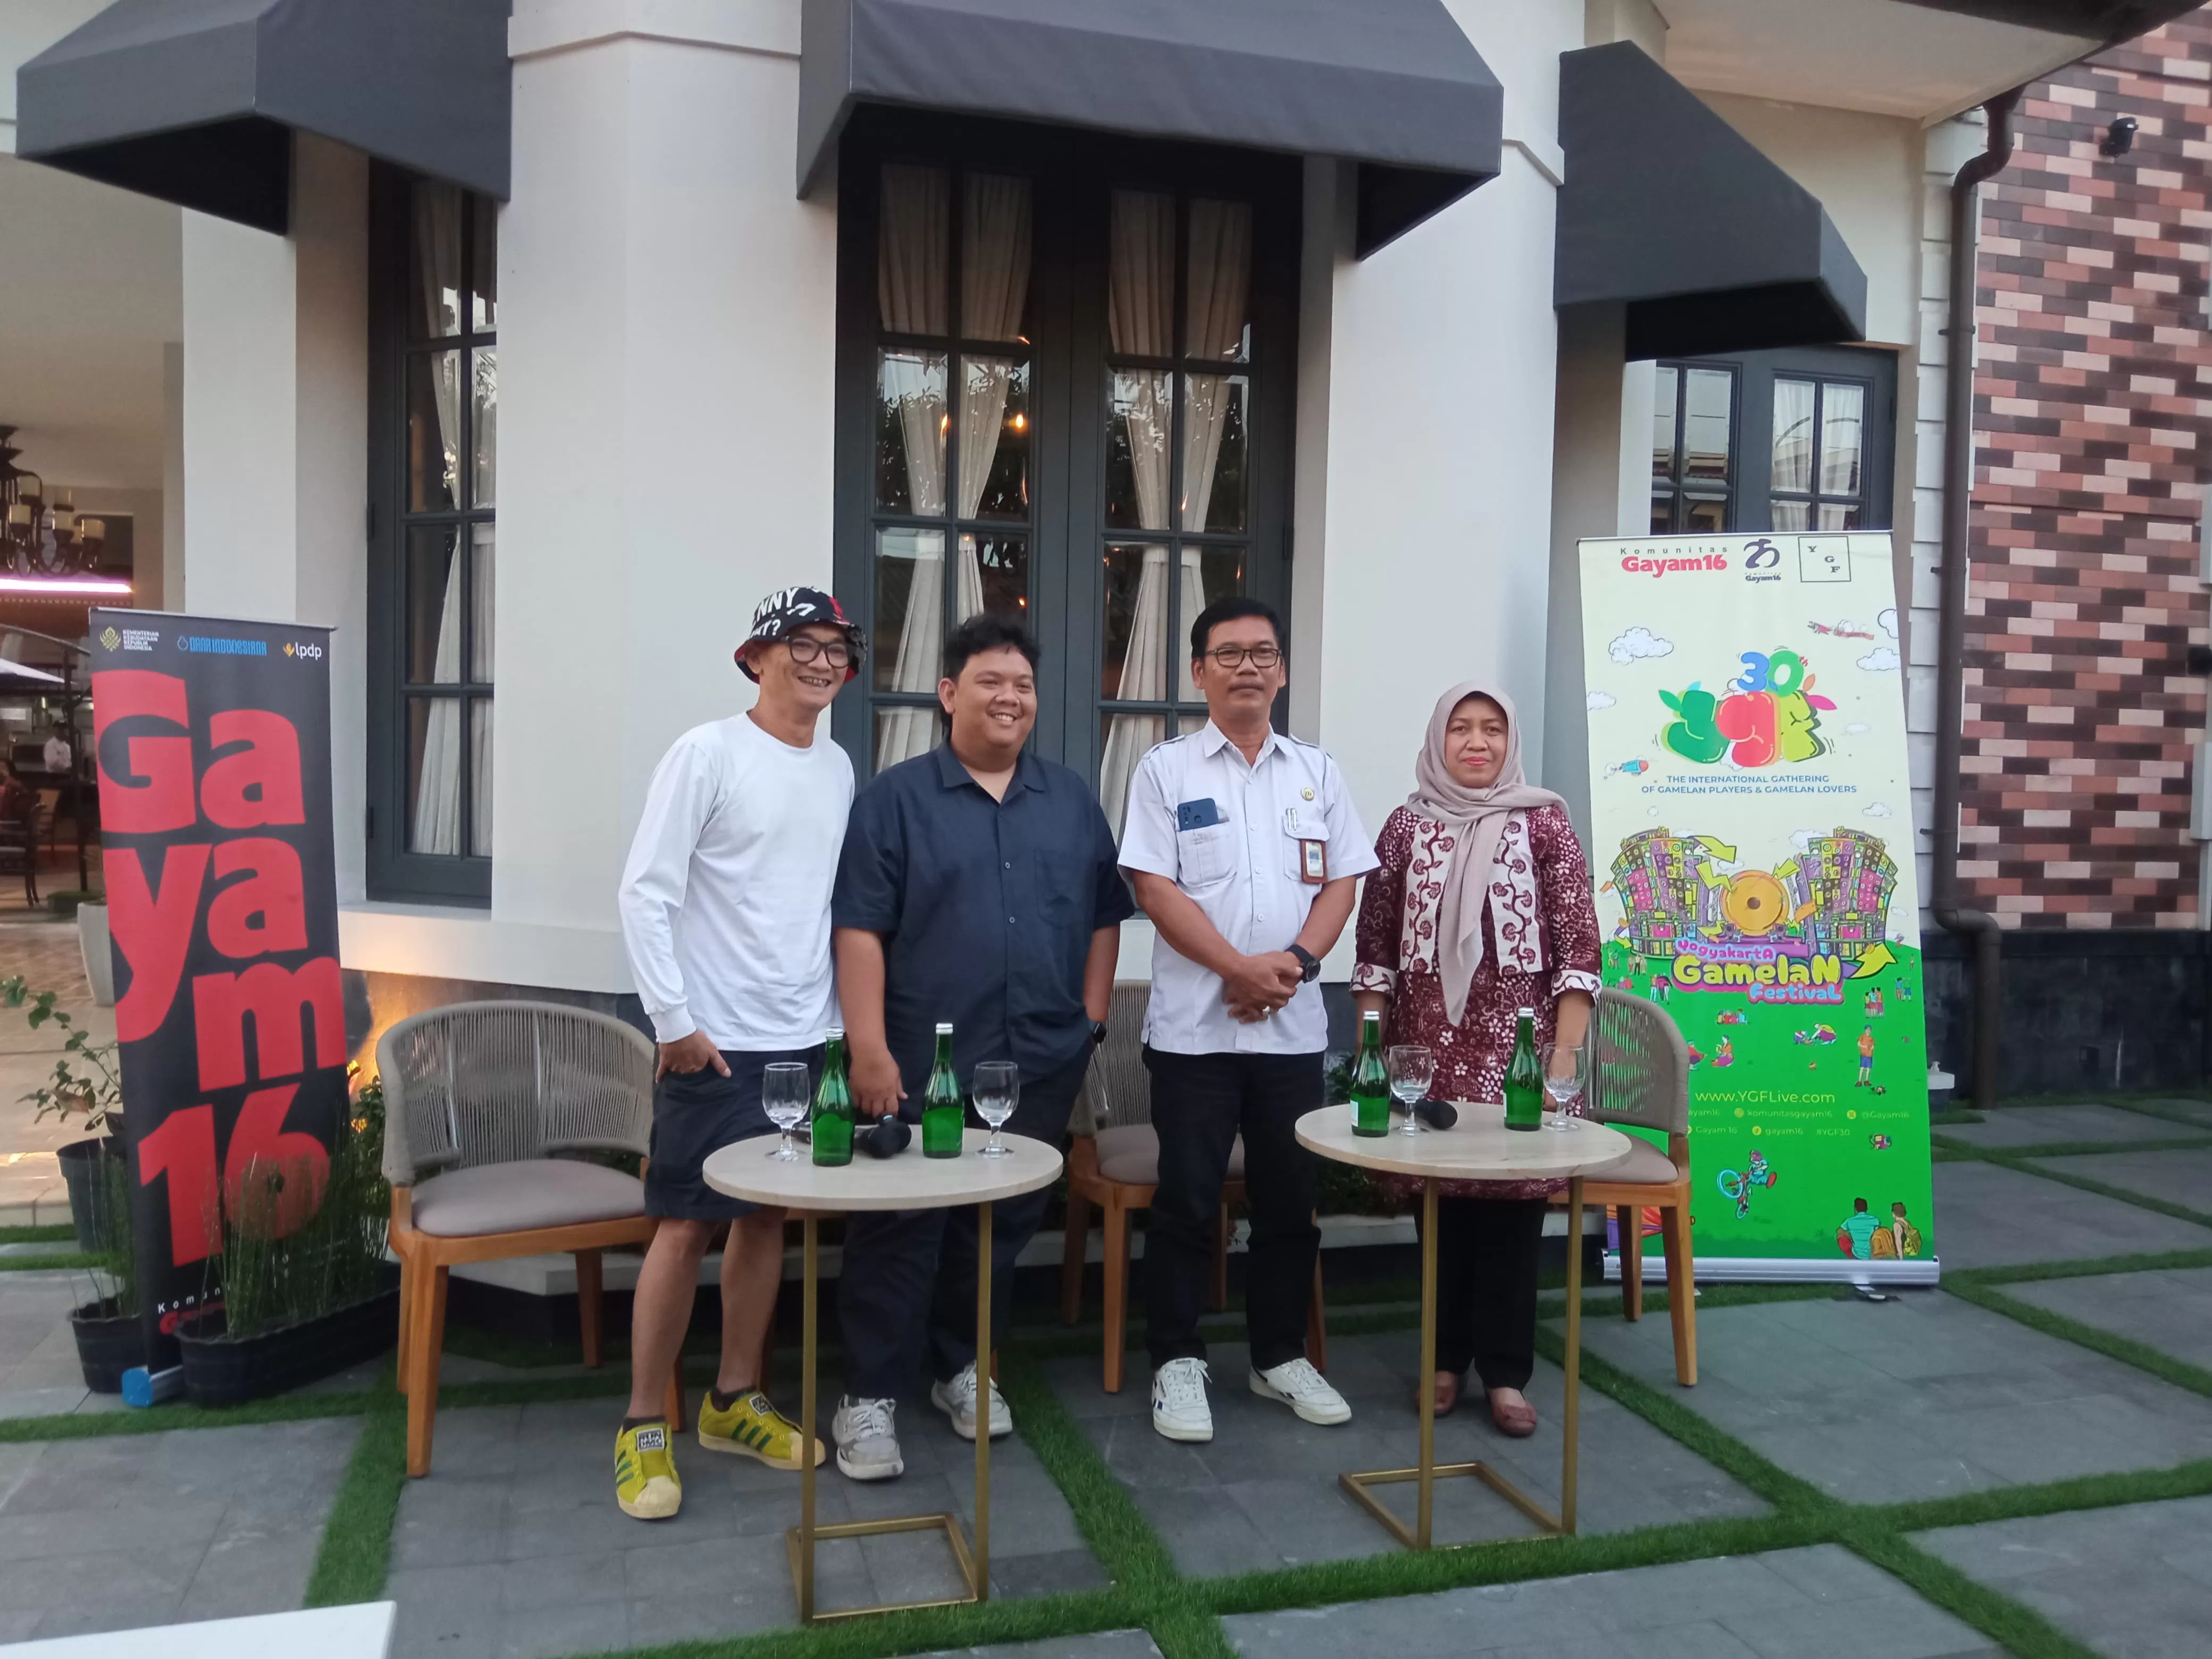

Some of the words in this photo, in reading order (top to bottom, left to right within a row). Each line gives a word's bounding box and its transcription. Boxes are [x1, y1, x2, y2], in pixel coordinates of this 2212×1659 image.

[1620, 546, 1728, 555] Komunitas
[1621, 554, 1728, 578] Gayam16
[1745, 575, 1781, 583] Gayam16
[295, 642, 322, 660] lpdp
[1695, 1090, 1835, 1103] www.YGFLive.com
[138, 1083, 331, 1267] 16
